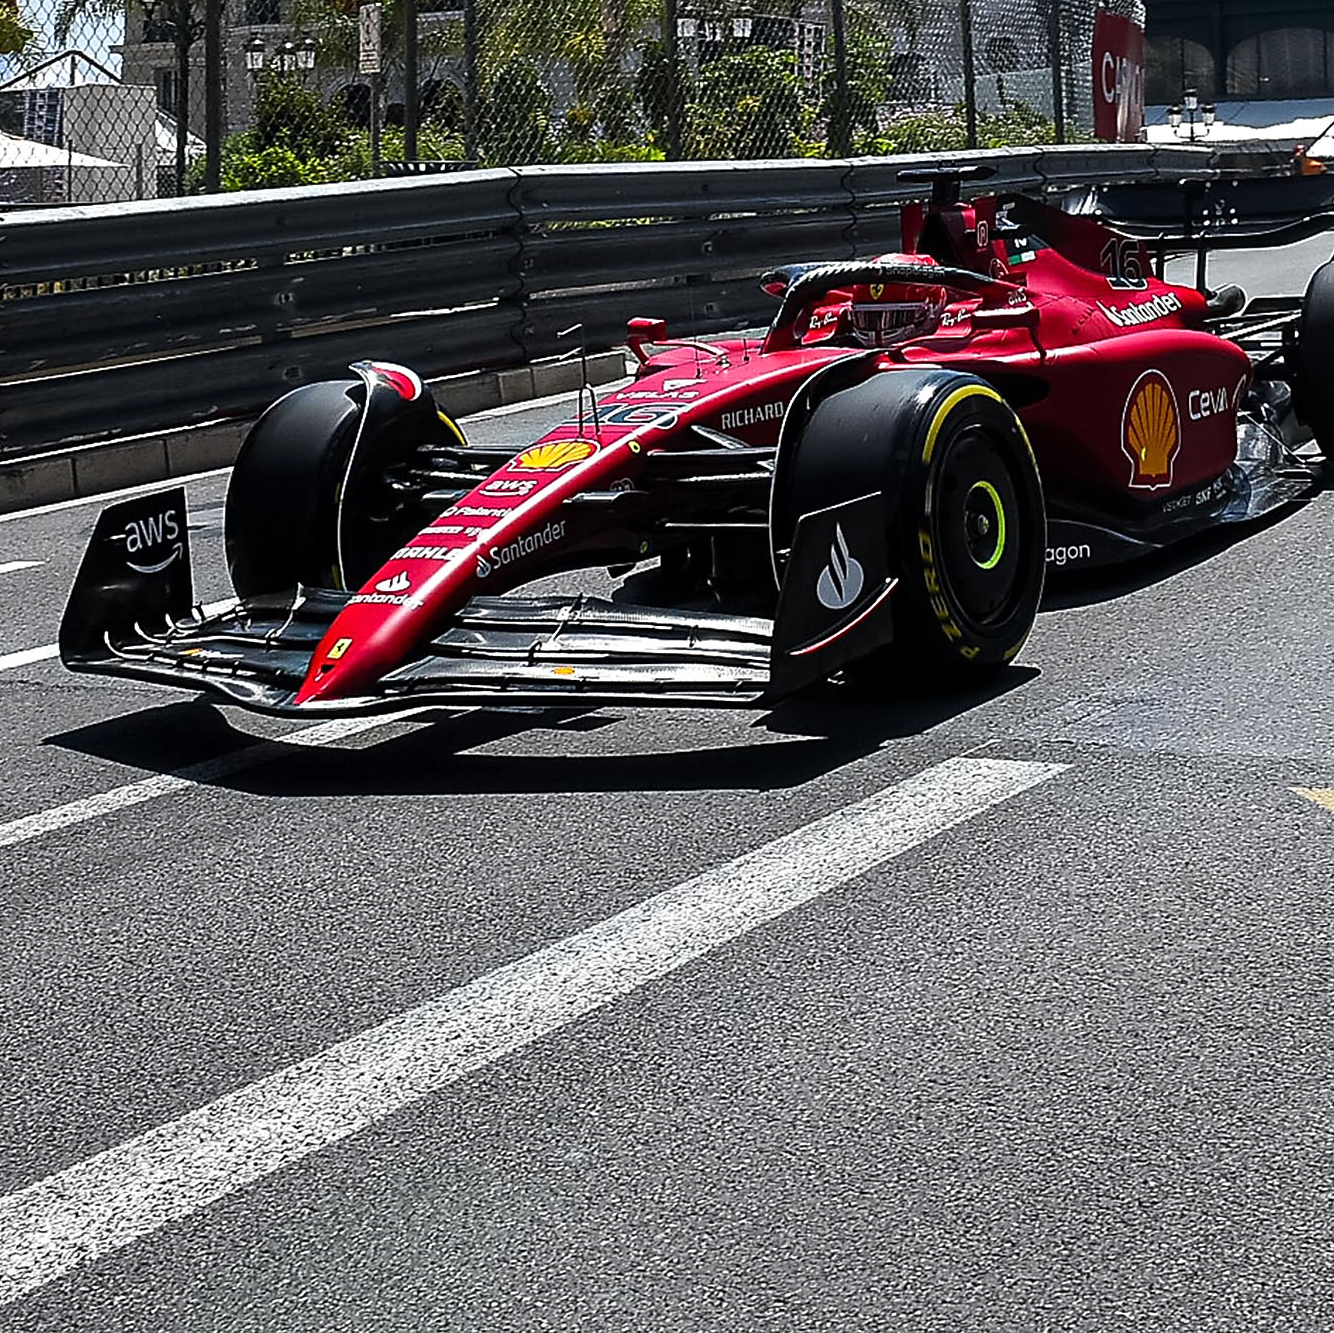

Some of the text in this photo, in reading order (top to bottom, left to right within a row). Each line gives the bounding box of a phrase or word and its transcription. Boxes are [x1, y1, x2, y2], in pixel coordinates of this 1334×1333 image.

[1100, 236, 1149, 291] 16
[1112, 291, 1183, 328] Santander
[561, 401, 679, 431] 16
[720, 400, 786, 431] RICHARD
[485, 478, 539, 493] aws
[124, 508, 180, 554] aws
[488, 518, 568, 571] Santander
